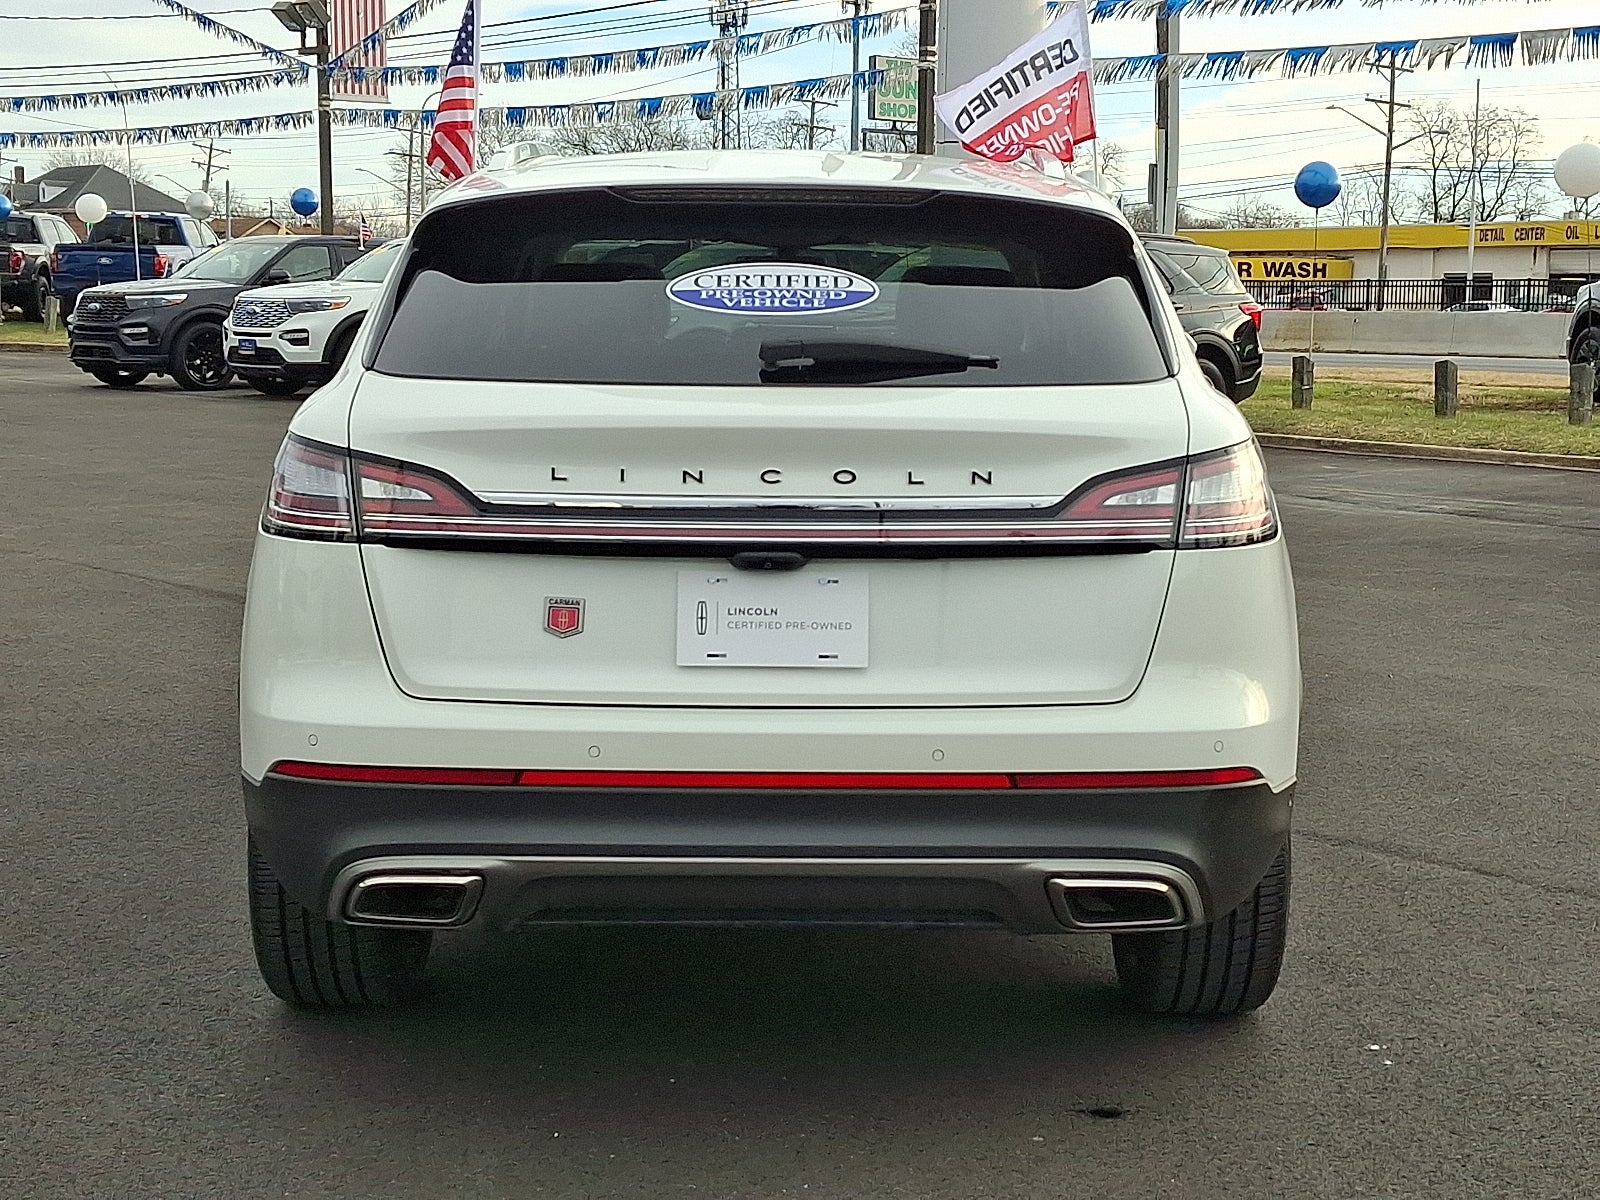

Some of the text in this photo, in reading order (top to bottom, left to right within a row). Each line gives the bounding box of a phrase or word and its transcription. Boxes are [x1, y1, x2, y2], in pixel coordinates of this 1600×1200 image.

[879, 102, 916, 118] SHOP
[1479, 228, 1505, 242] DETAIL
[1514, 227, 1546, 241] CENTER
[1565, 225, 1580, 240] OIL
[1262, 261, 1328, 279] WASH
[693, 274, 854, 289] CERTIFIED
[700, 289, 847, 300] PRE-OWNED
[721, 298, 826, 308] VEHICLE
[551, 466, 993, 486] LINCOLN
[548, 598, 581, 606] CARMAN
[727, 607, 778, 616] LINCOLN
[727, 620, 853, 630] CERTIFIED PRE-OWNED
